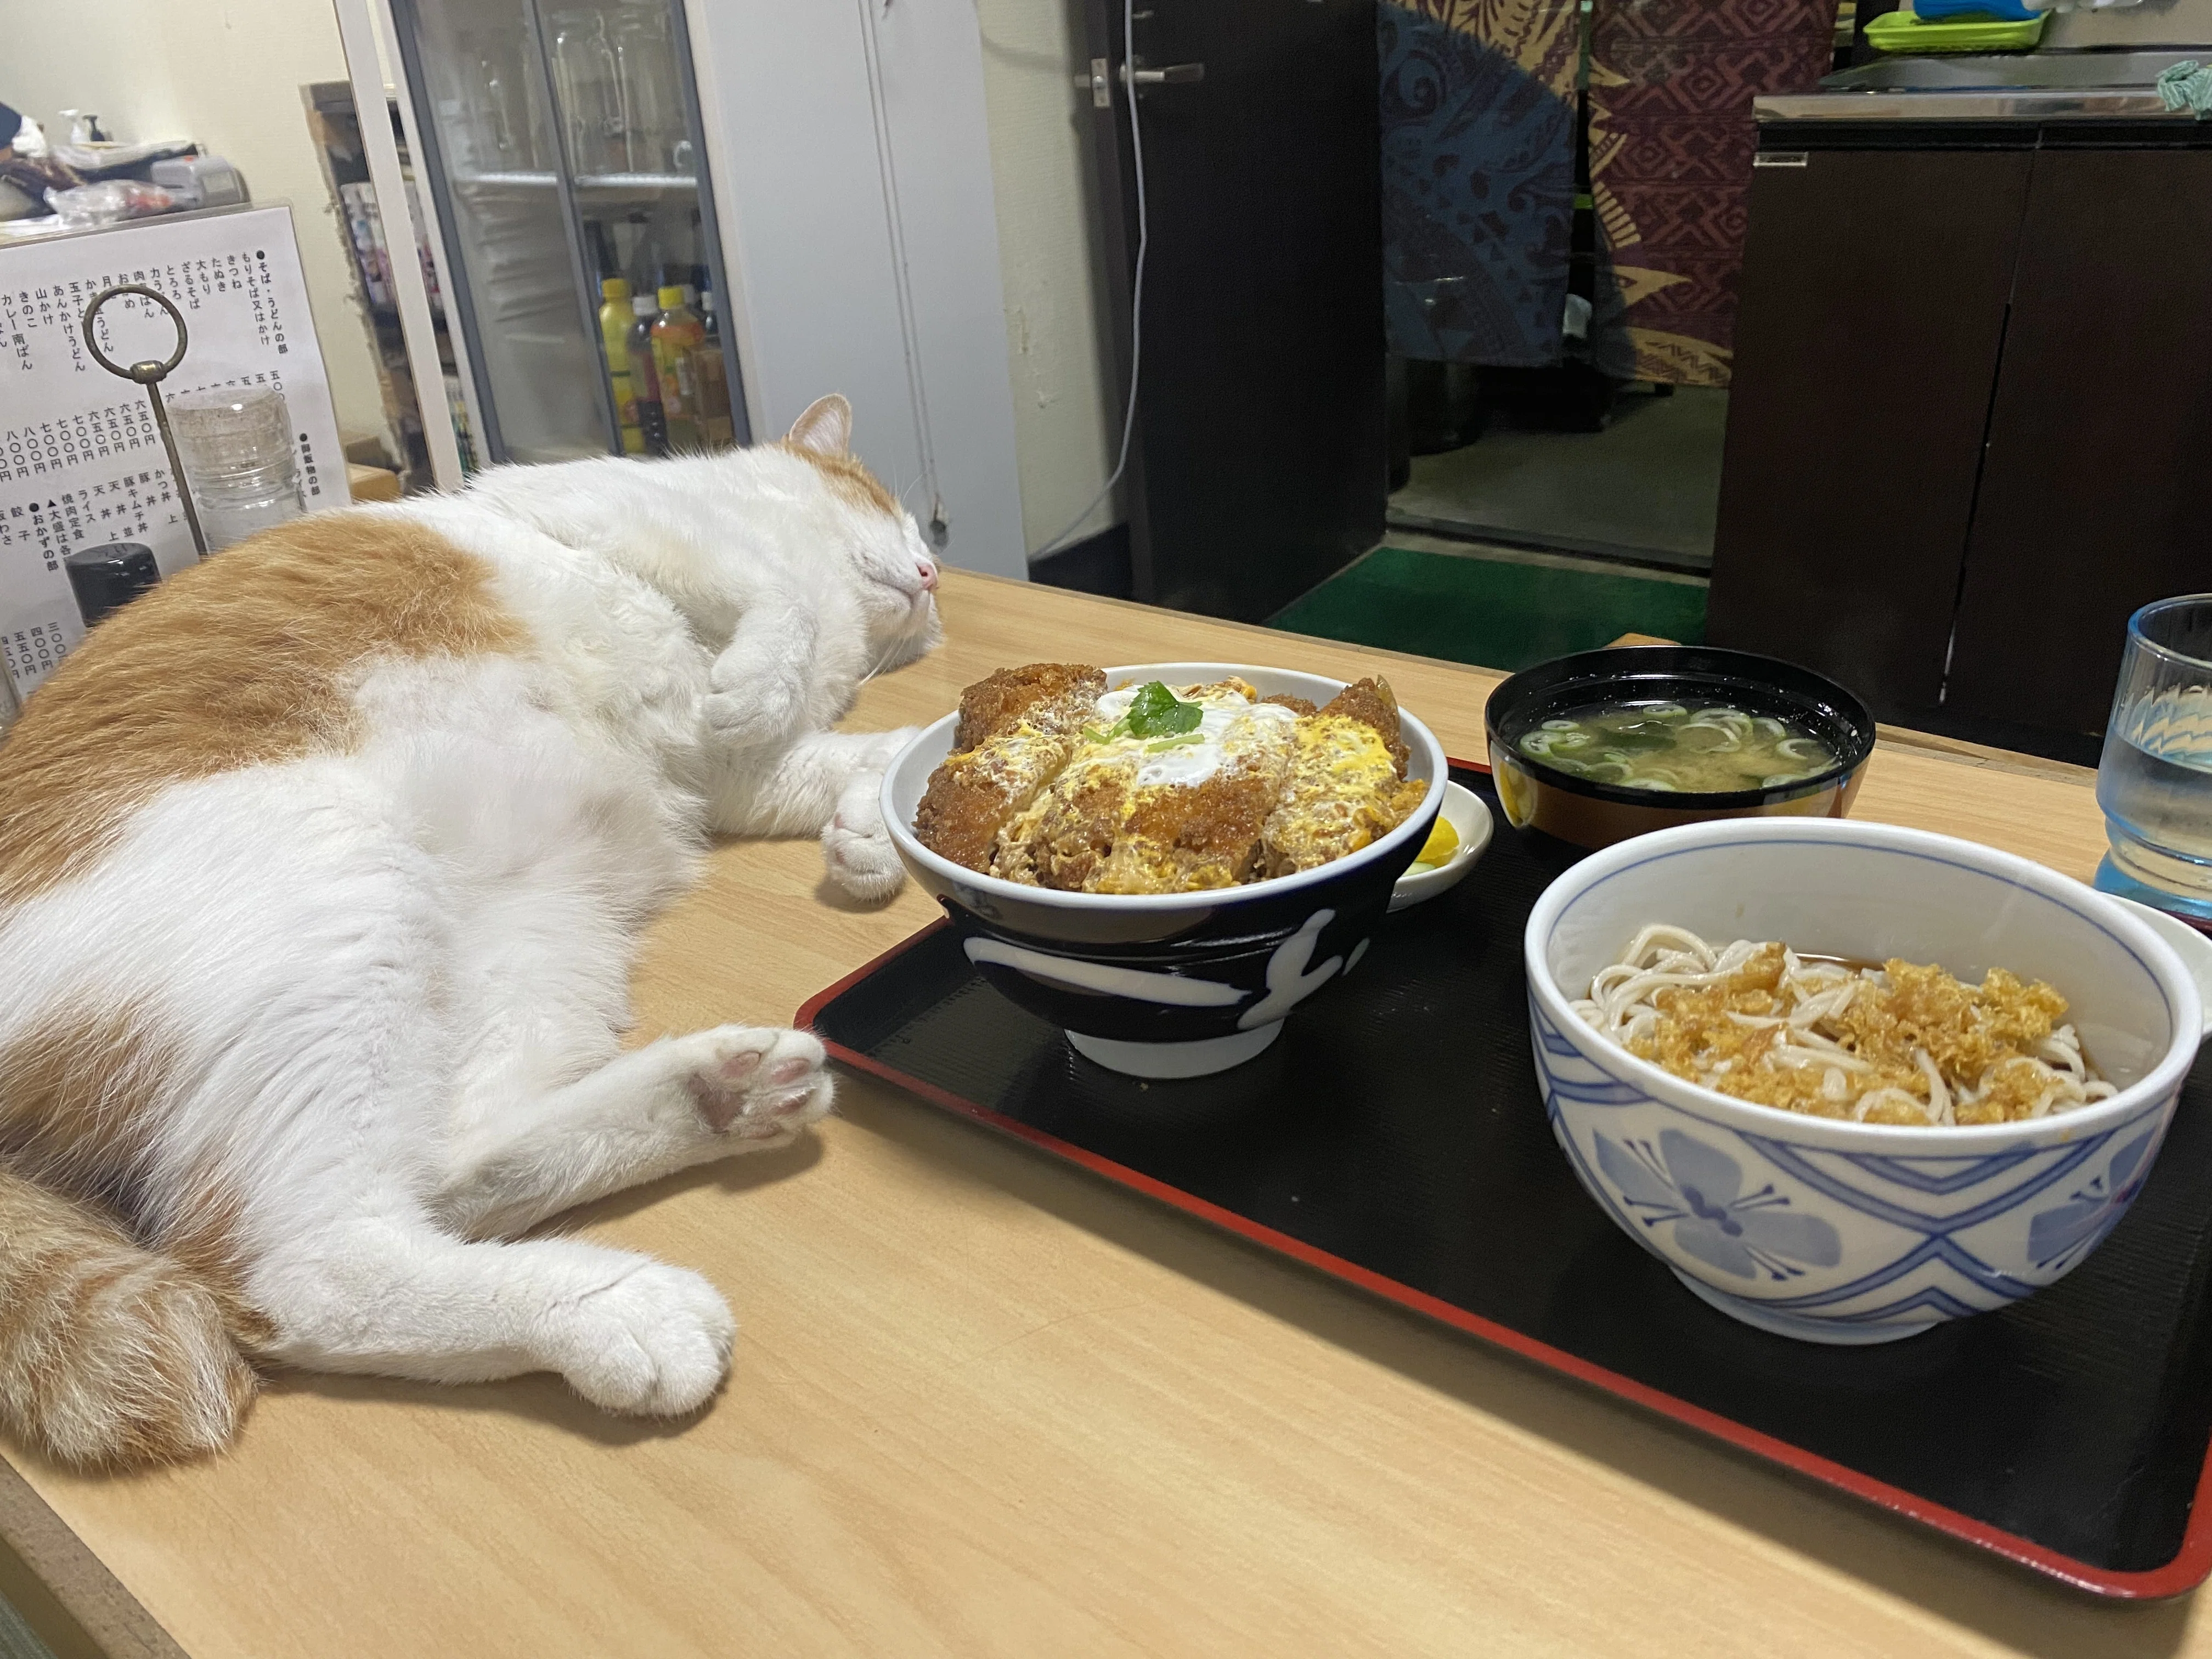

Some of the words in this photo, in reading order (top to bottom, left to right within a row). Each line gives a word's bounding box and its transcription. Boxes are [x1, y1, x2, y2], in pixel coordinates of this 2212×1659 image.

[119, 273, 135, 308] おめ
[167, 265, 182, 300] とろろ
[181, 261, 201, 309] ざるそば
[196, 259, 211, 295] 大もり
[212, 257, 226, 292] たぬき
[227, 255, 242, 289] きつね
[19, 291, 37, 328] きのこ
[36, 288, 53, 325] 山かけ
[242, 252, 269, 345] もりそば又はかけ
[258, 262, 288, 354] そば・うどんの部
[2, 294, 32, 370] カレー南ばん
[53, 285, 85, 372] あんかけうどん
[62, 494, 84, 540] 焼肉定食
[78, 489, 95, 523] ライス
[123, 476, 148, 533] 豚キムチ丼
[33, 515, 59, 571] おかずの部
[49, 510, 71, 555] 大盛は各
